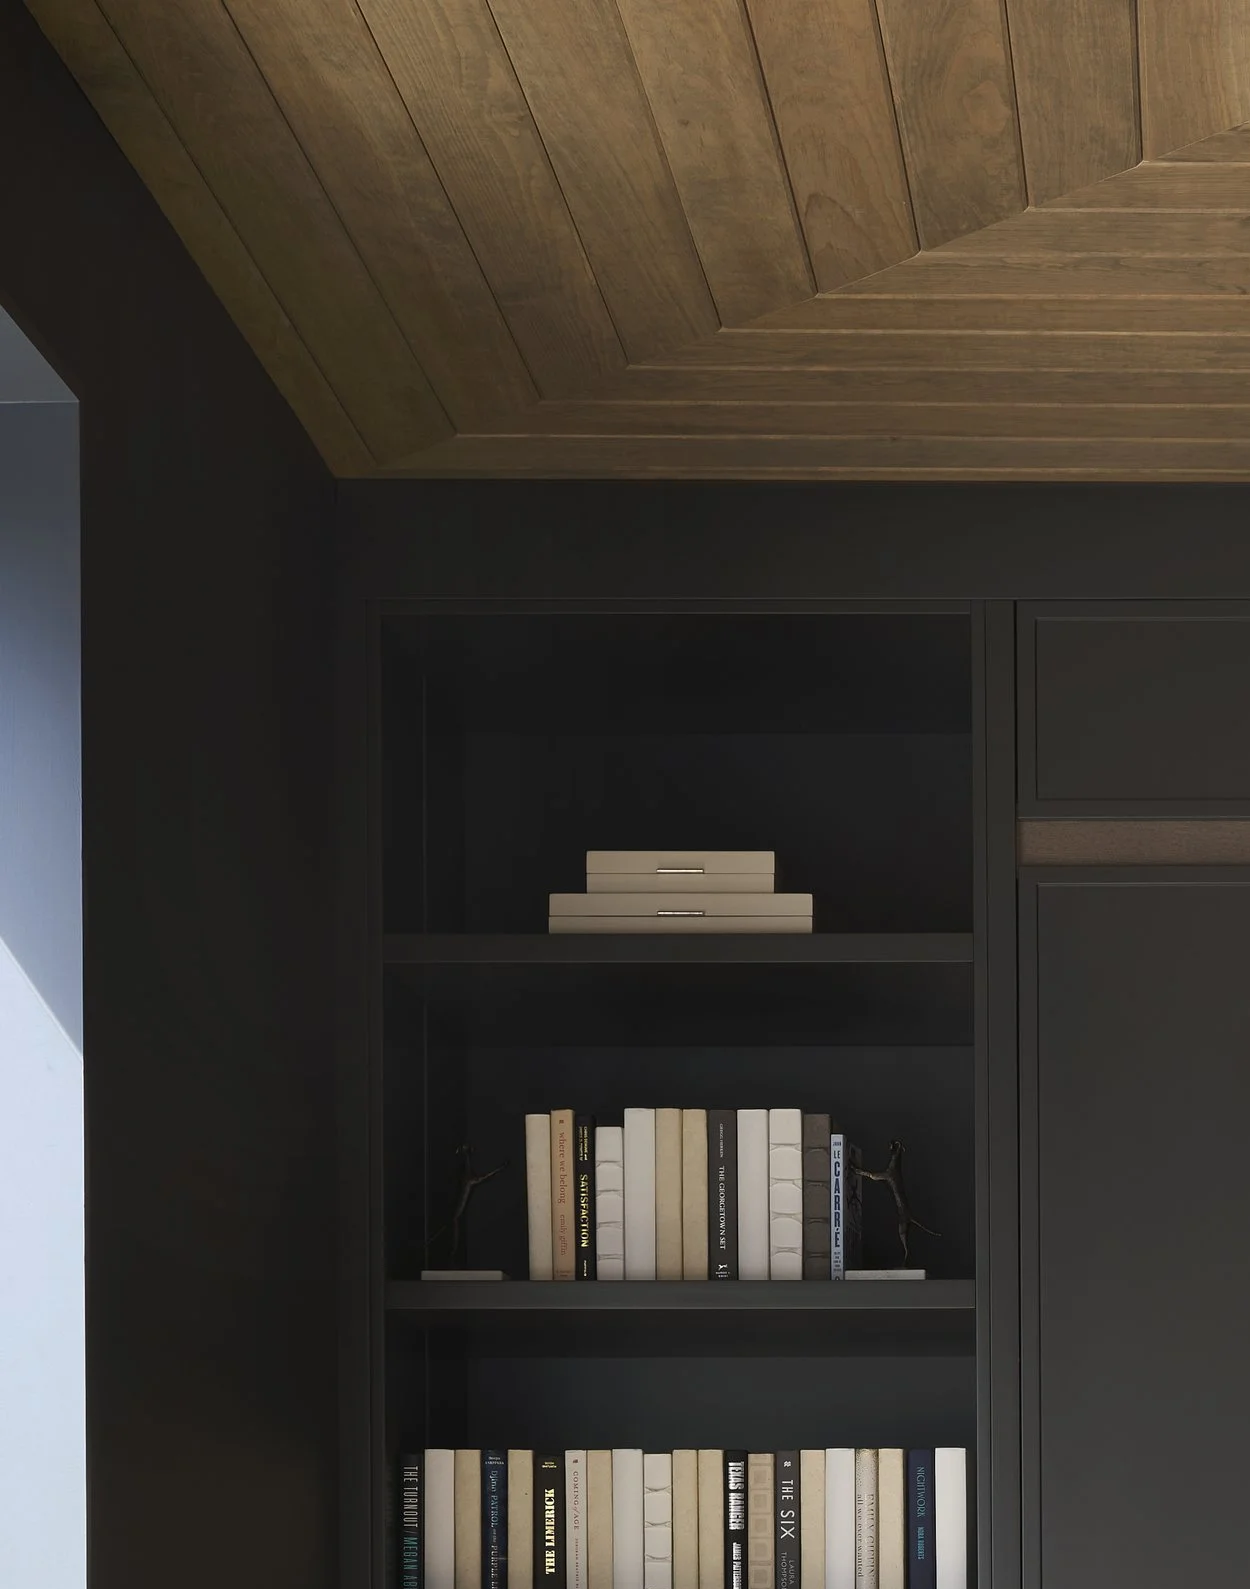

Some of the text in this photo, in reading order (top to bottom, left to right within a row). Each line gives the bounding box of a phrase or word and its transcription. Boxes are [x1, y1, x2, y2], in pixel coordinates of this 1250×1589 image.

[558, 1132, 568, 1204] where we belong
[834, 1151, 840, 1159] LE
[580, 1174, 589, 1248] SATISFACTION
[404, 1466, 418, 1528] THE TURNOUT
[490, 1494, 498, 1528] PATROL
[728, 1462, 744, 1530] TEXAS RANGER
[780, 1480, 795, 1539] THE SIX
[916, 1466, 926, 1518] NIGHTWORK
[404, 1536, 418, 1570] MEGAN
[544, 1488, 556, 1575] THE LIMERICK
[732, 1542, 742, 1589] JAMES PATTERSON
